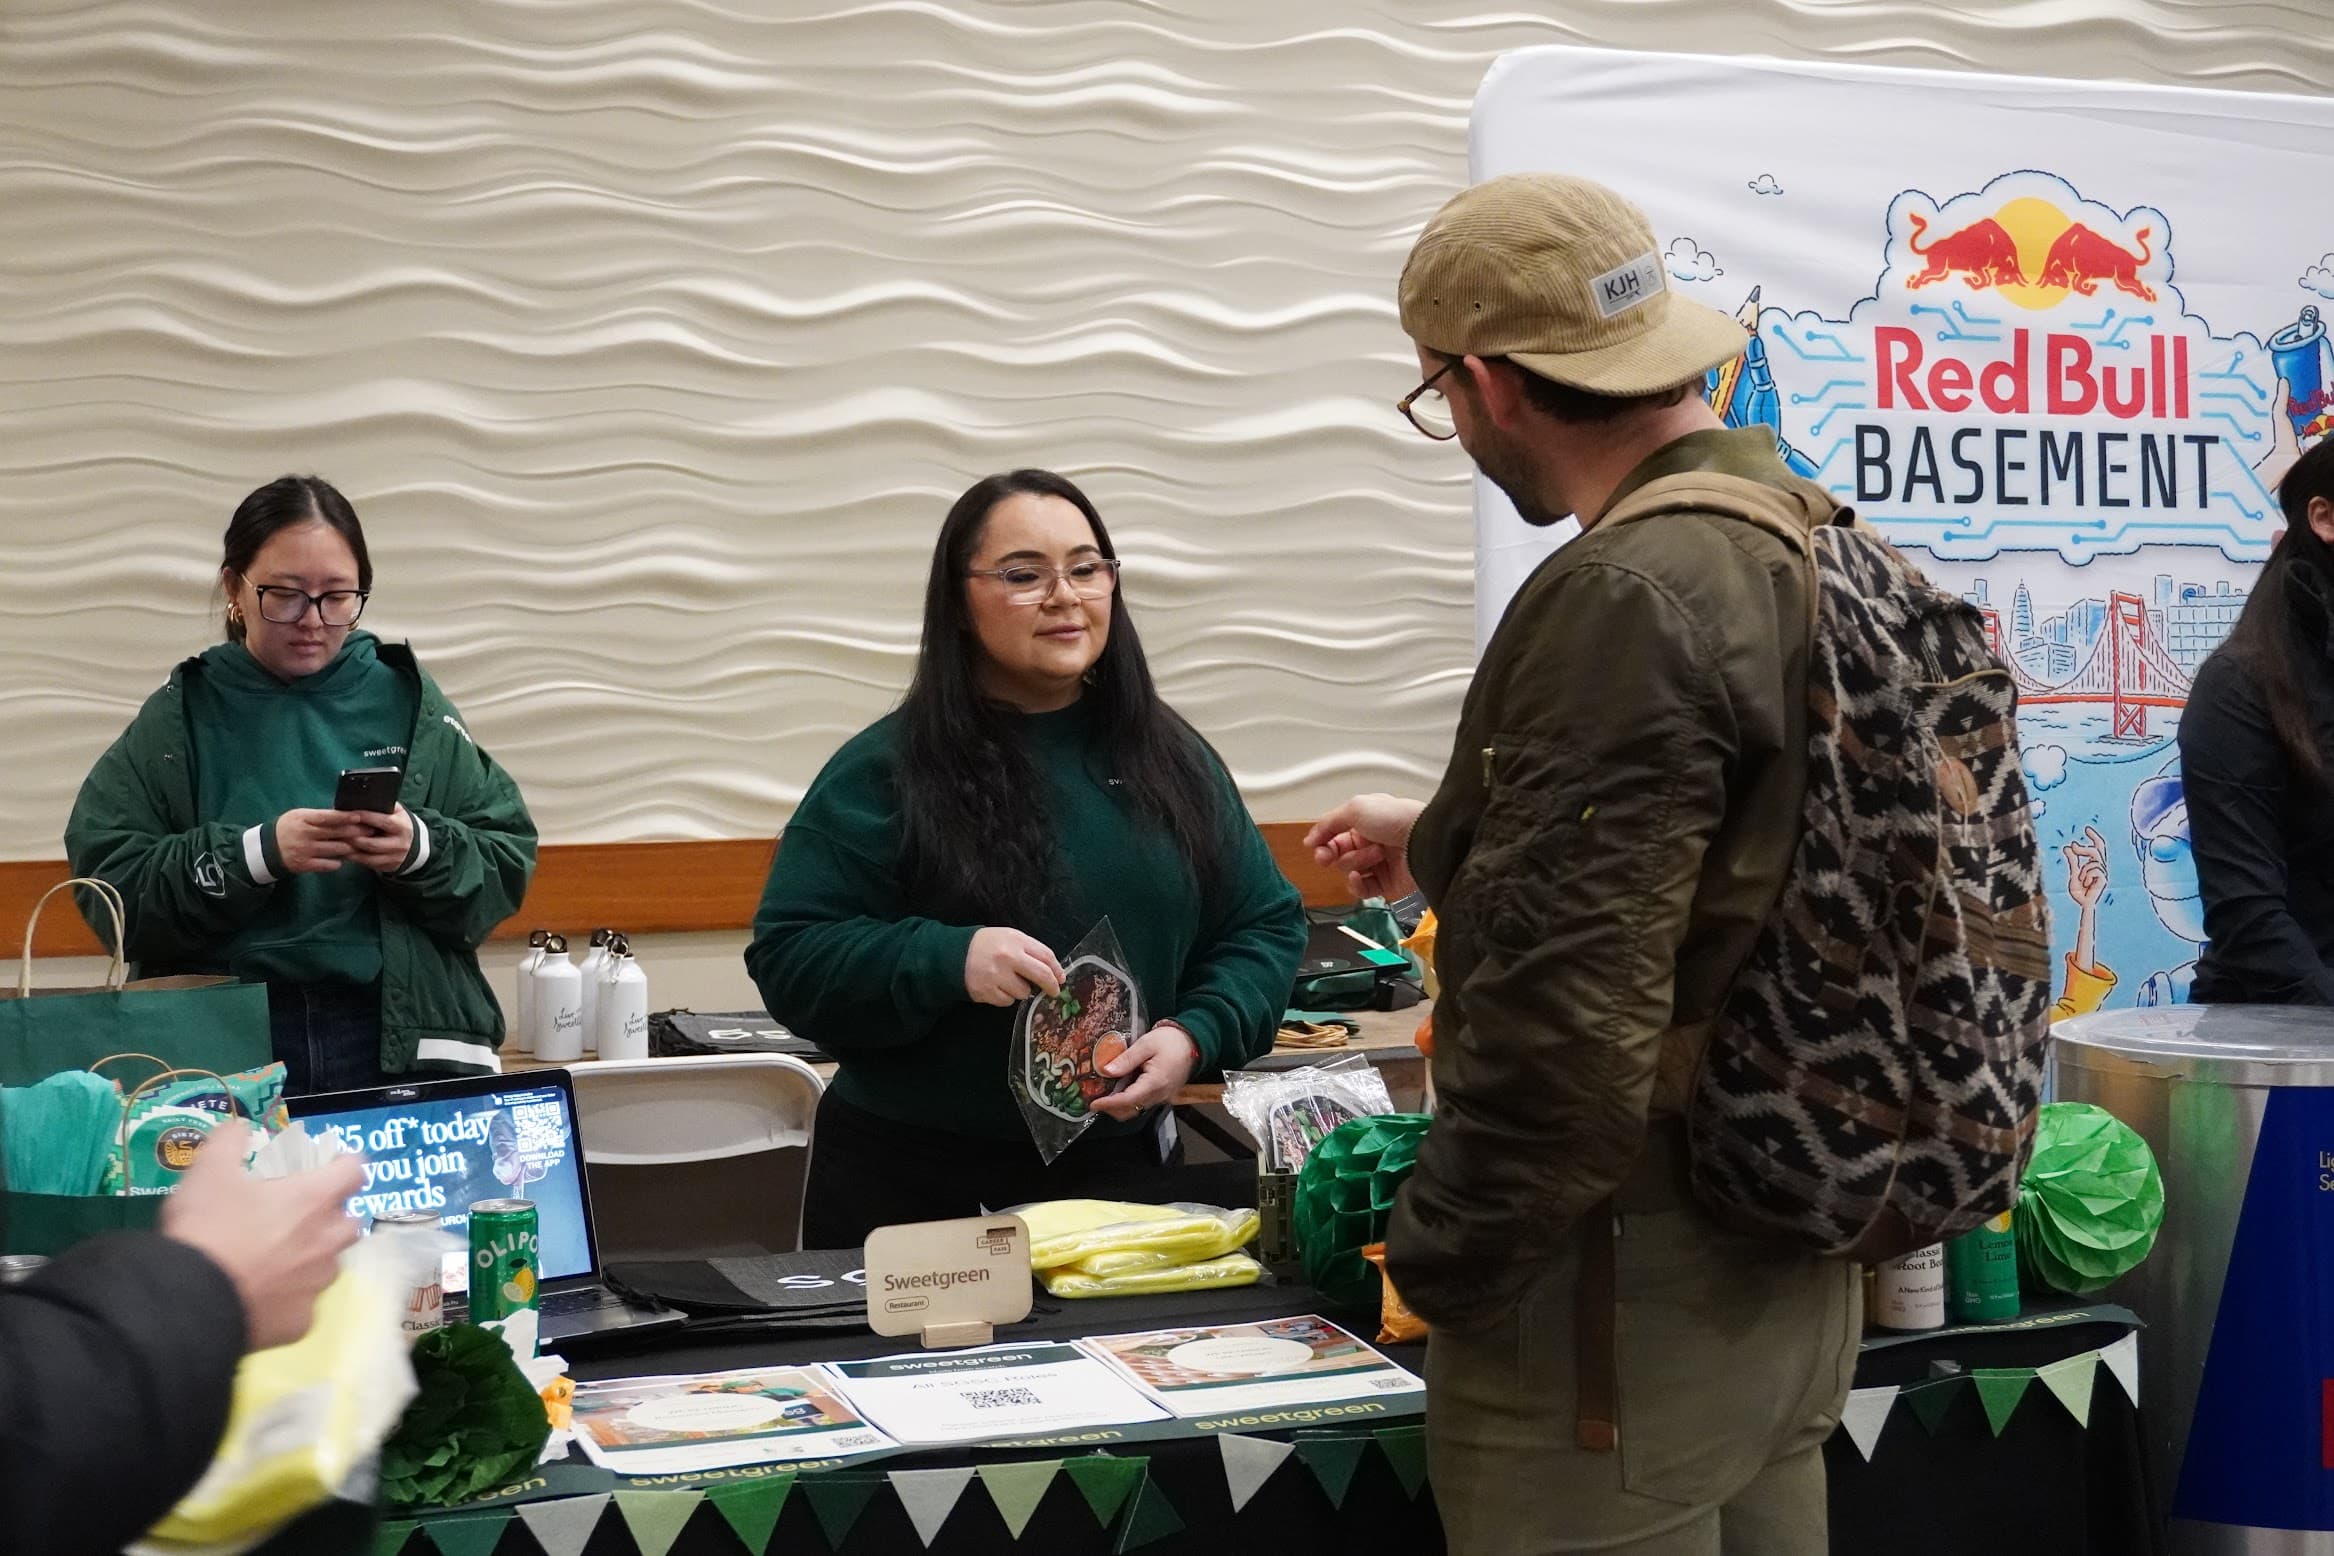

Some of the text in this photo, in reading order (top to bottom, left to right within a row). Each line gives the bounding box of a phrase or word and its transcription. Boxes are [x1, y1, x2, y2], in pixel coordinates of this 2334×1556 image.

[1604, 270, 1640, 300] KJH
[1874, 326, 2190, 420] Red Bull
[1855, 424, 2219, 509] BASEMENT
[190, 1099, 228, 1110] IETE
[421, 1111, 494, 1145] today
[361, 1146, 467, 1191] you join
[520, 1150, 565, 1163] DOWNLOAD
[544, 1159, 560, 1168] APP
[346, 1178, 447, 1218] ewards
[884, 1268, 990, 1291] Sweetgreen
[889, 1300, 924, 1310] Restaurant
[889, 1353, 1033, 1371] sweetgreen
[1195, 1401, 1386, 1431] sweetgreen
[629, 1458, 844, 1487] sweetgreen
